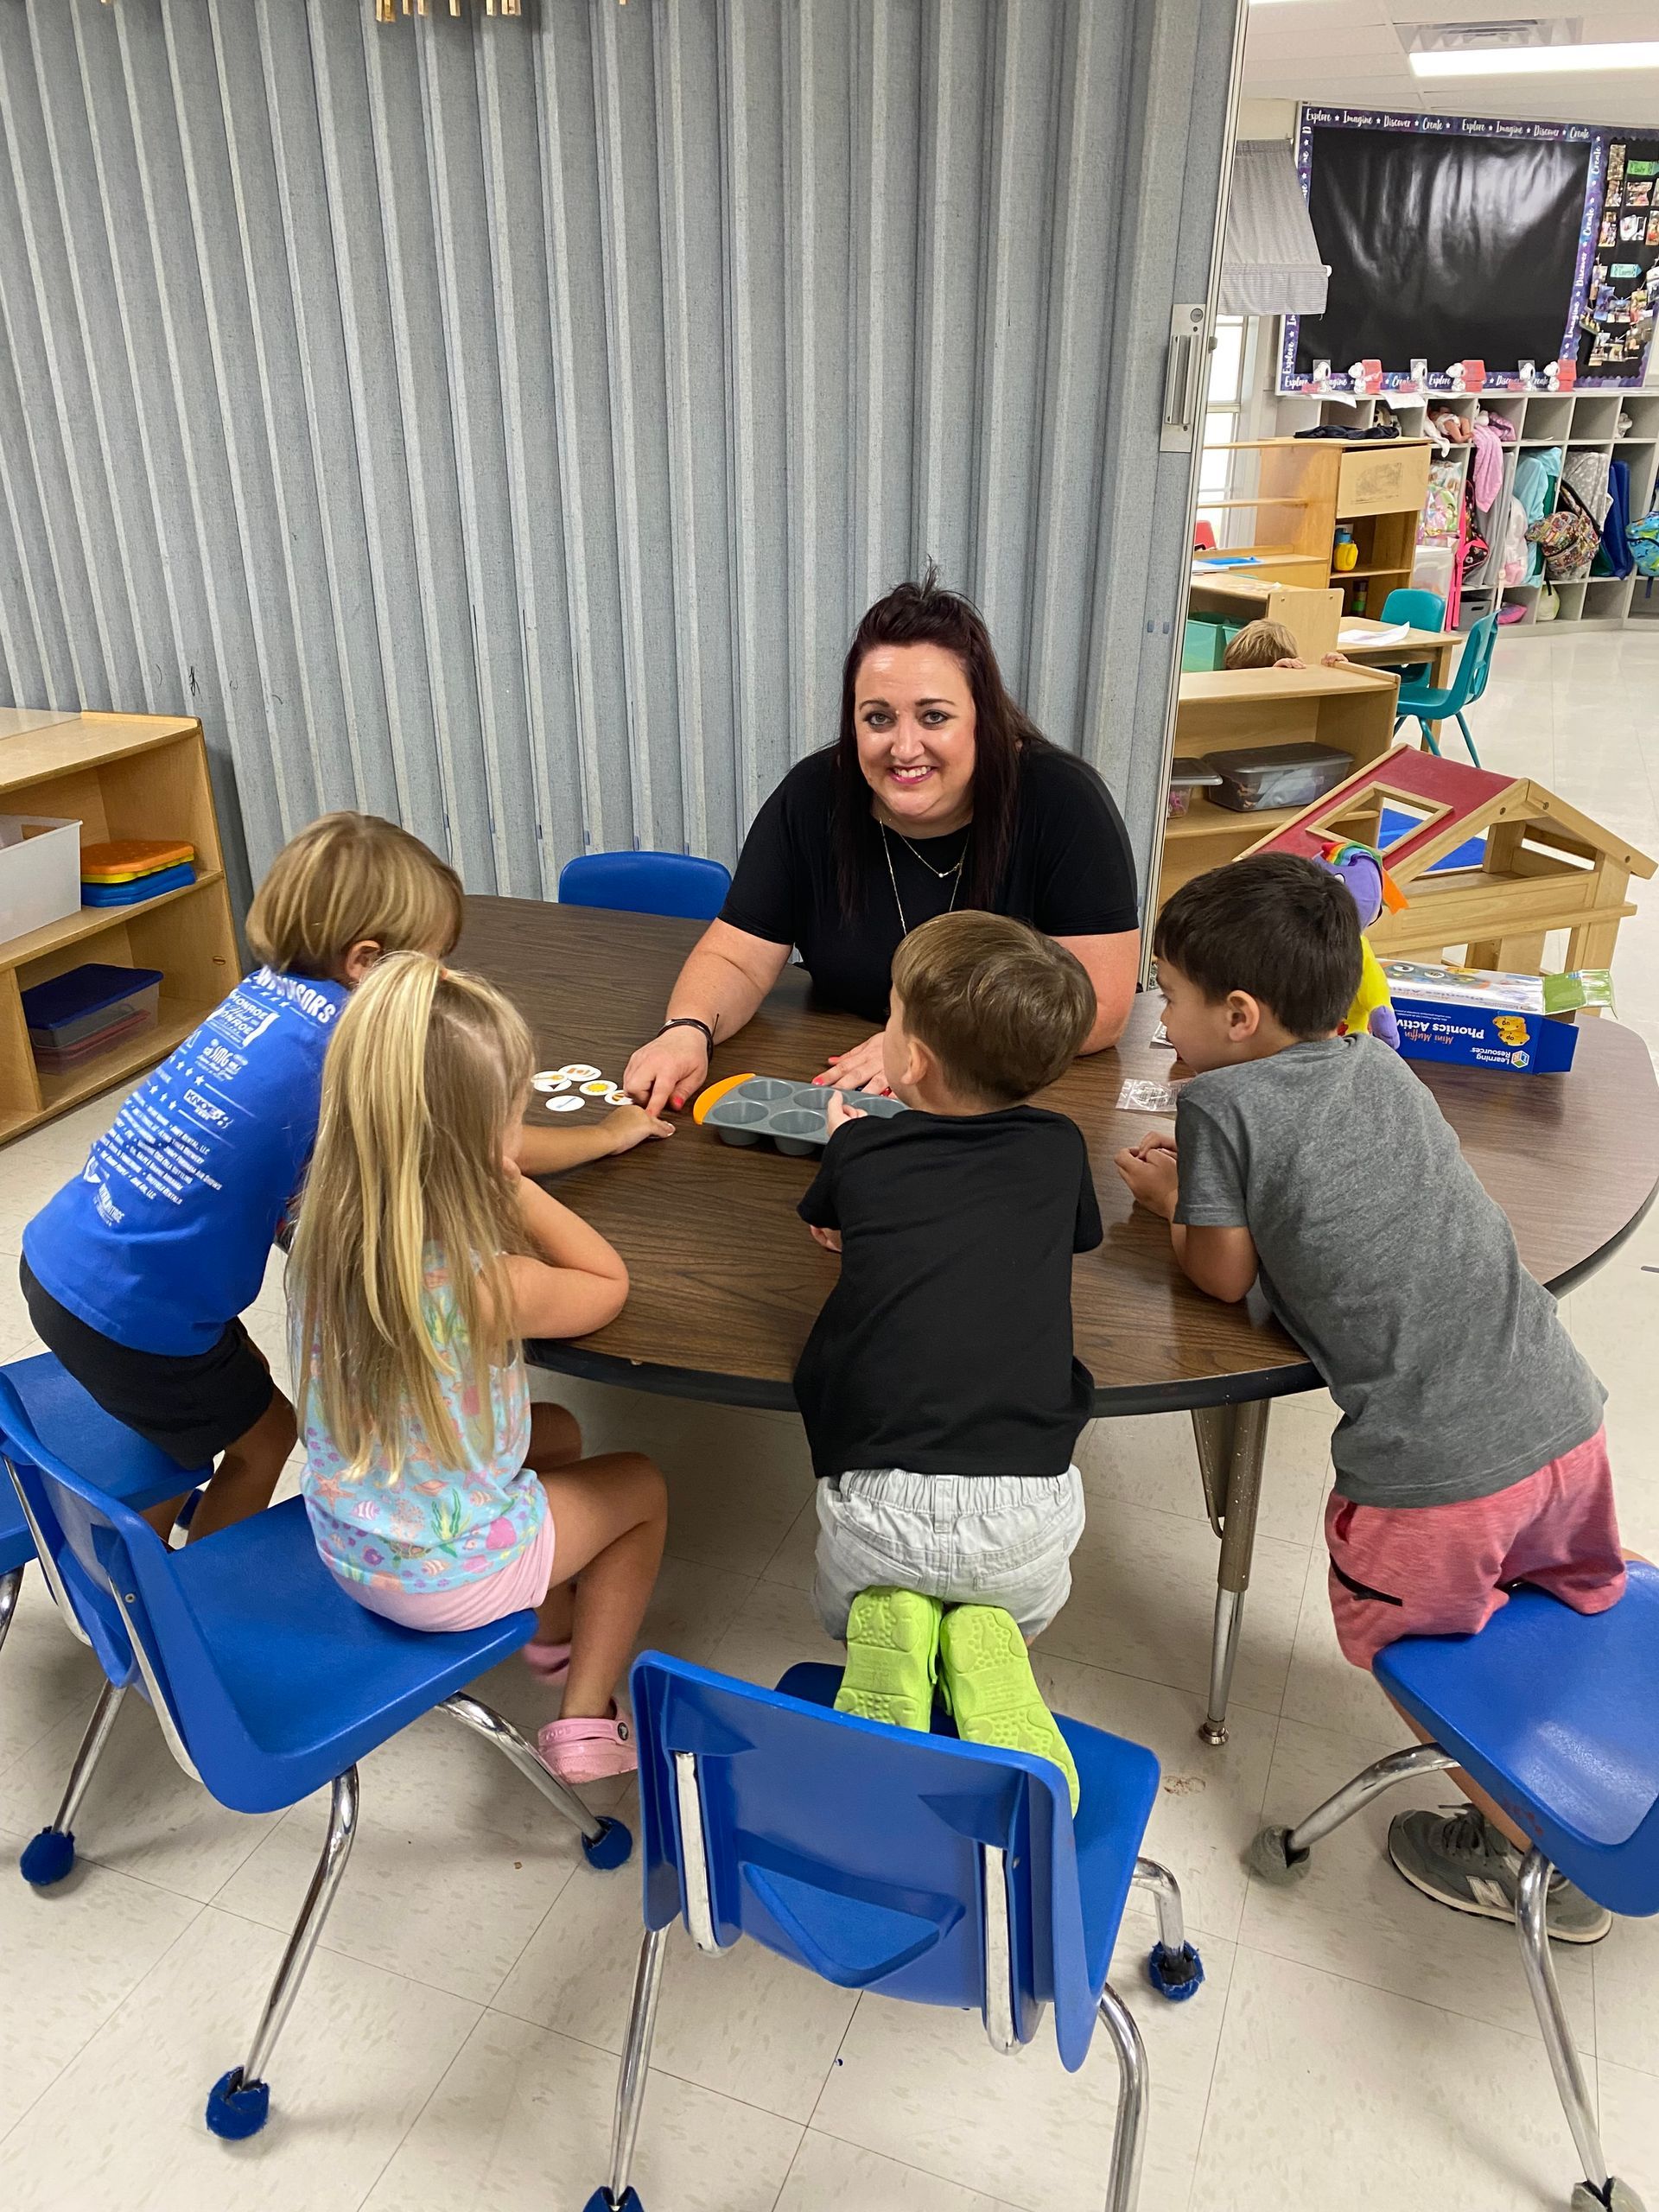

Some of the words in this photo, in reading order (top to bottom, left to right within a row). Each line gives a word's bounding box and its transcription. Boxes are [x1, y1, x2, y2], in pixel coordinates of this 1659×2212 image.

[1306, 109, 1332, 123] Explore
[1343, 111, 1372, 127] Imagine
[1383, 116, 1411, 128] Discover
[1422, 118, 1443, 130] Create
[1462, 116, 1485, 131] Explore
[1496, 121, 1523, 136] Imagine
[1534, 124, 1560, 137] Discover
[1570, 127, 1591, 139] Create
[1564, 302, 1580, 339] Imagine
[1574, 252, 1587, 287] Discover
[1582, 207, 1595, 237] Create
[1590, 146, 1602, 175] Create
[1282, 341, 1295, 375] Explore
[1396, 1019, 1430, 1030] Activ
[1433, 1023, 1484, 1039] Phonics
[1404, 1028, 1432, 1041] Muffin
[1434, 1034, 1453, 1045] Mini
[1471, 1047, 1511, 1058] Resources
[1476, 1054, 1510, 1065] Learning
[185, 1091, 217, 1116] KNOE
